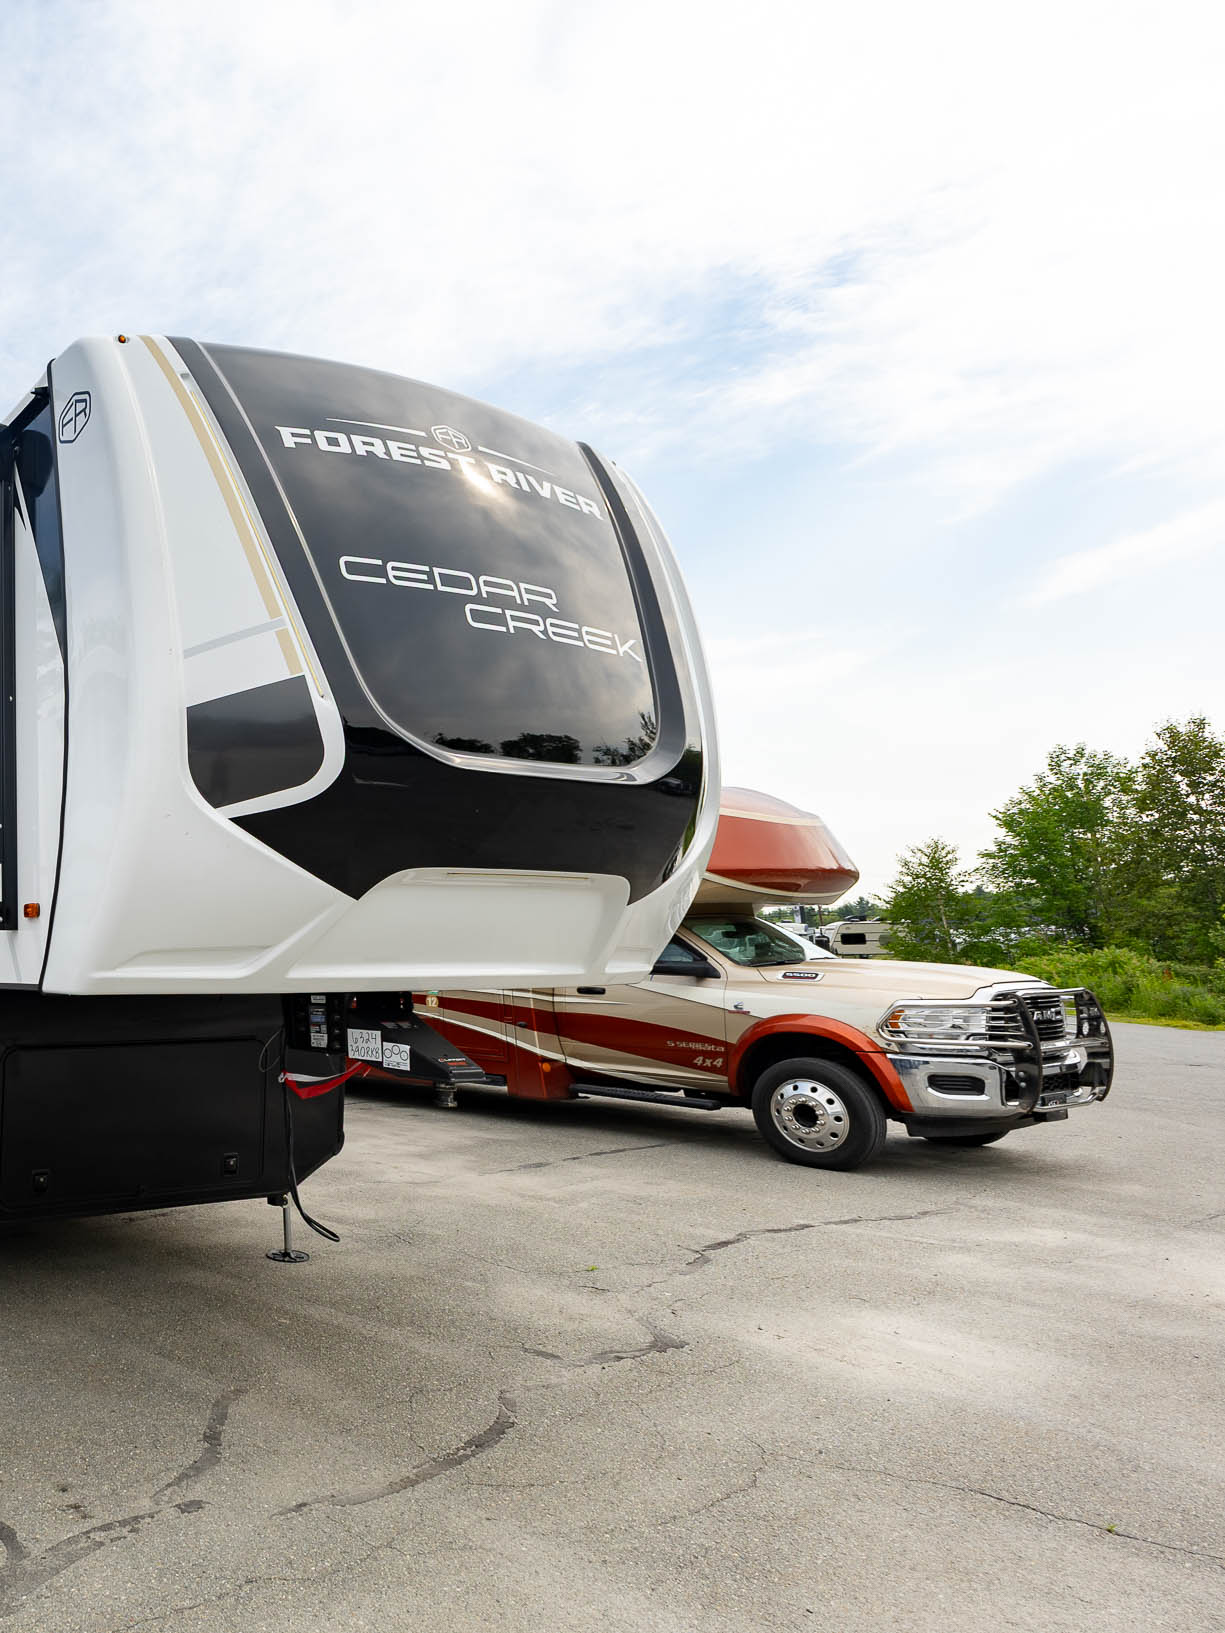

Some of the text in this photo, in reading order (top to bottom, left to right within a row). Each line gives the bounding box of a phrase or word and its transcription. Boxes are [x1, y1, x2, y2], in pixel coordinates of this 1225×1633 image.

[274, 425, 604, 521] FOREST RIVER
[339, 555, 560, 613] CEDAR
[464, 603, 643, 663] CREEK
[426, 997, 438, 1007] 12
[351, 1031, 377, 1045] 6324
[693, 1056, 724, 1067] 4x4
